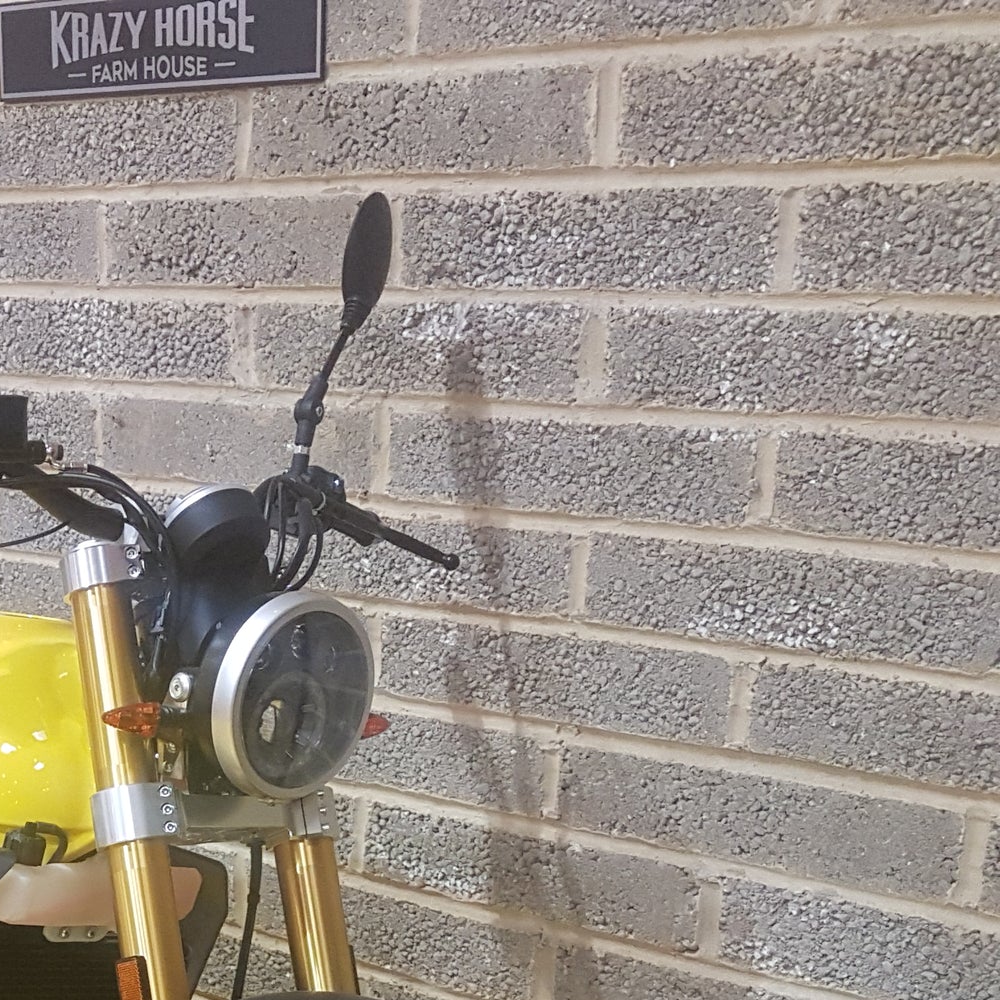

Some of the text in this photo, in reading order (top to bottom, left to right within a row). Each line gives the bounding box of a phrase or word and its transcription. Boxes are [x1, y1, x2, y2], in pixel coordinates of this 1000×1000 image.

[50, 0, 254, 69] KRAZY HORSE
[92, 55, 208, 83] FARM HOUSE
